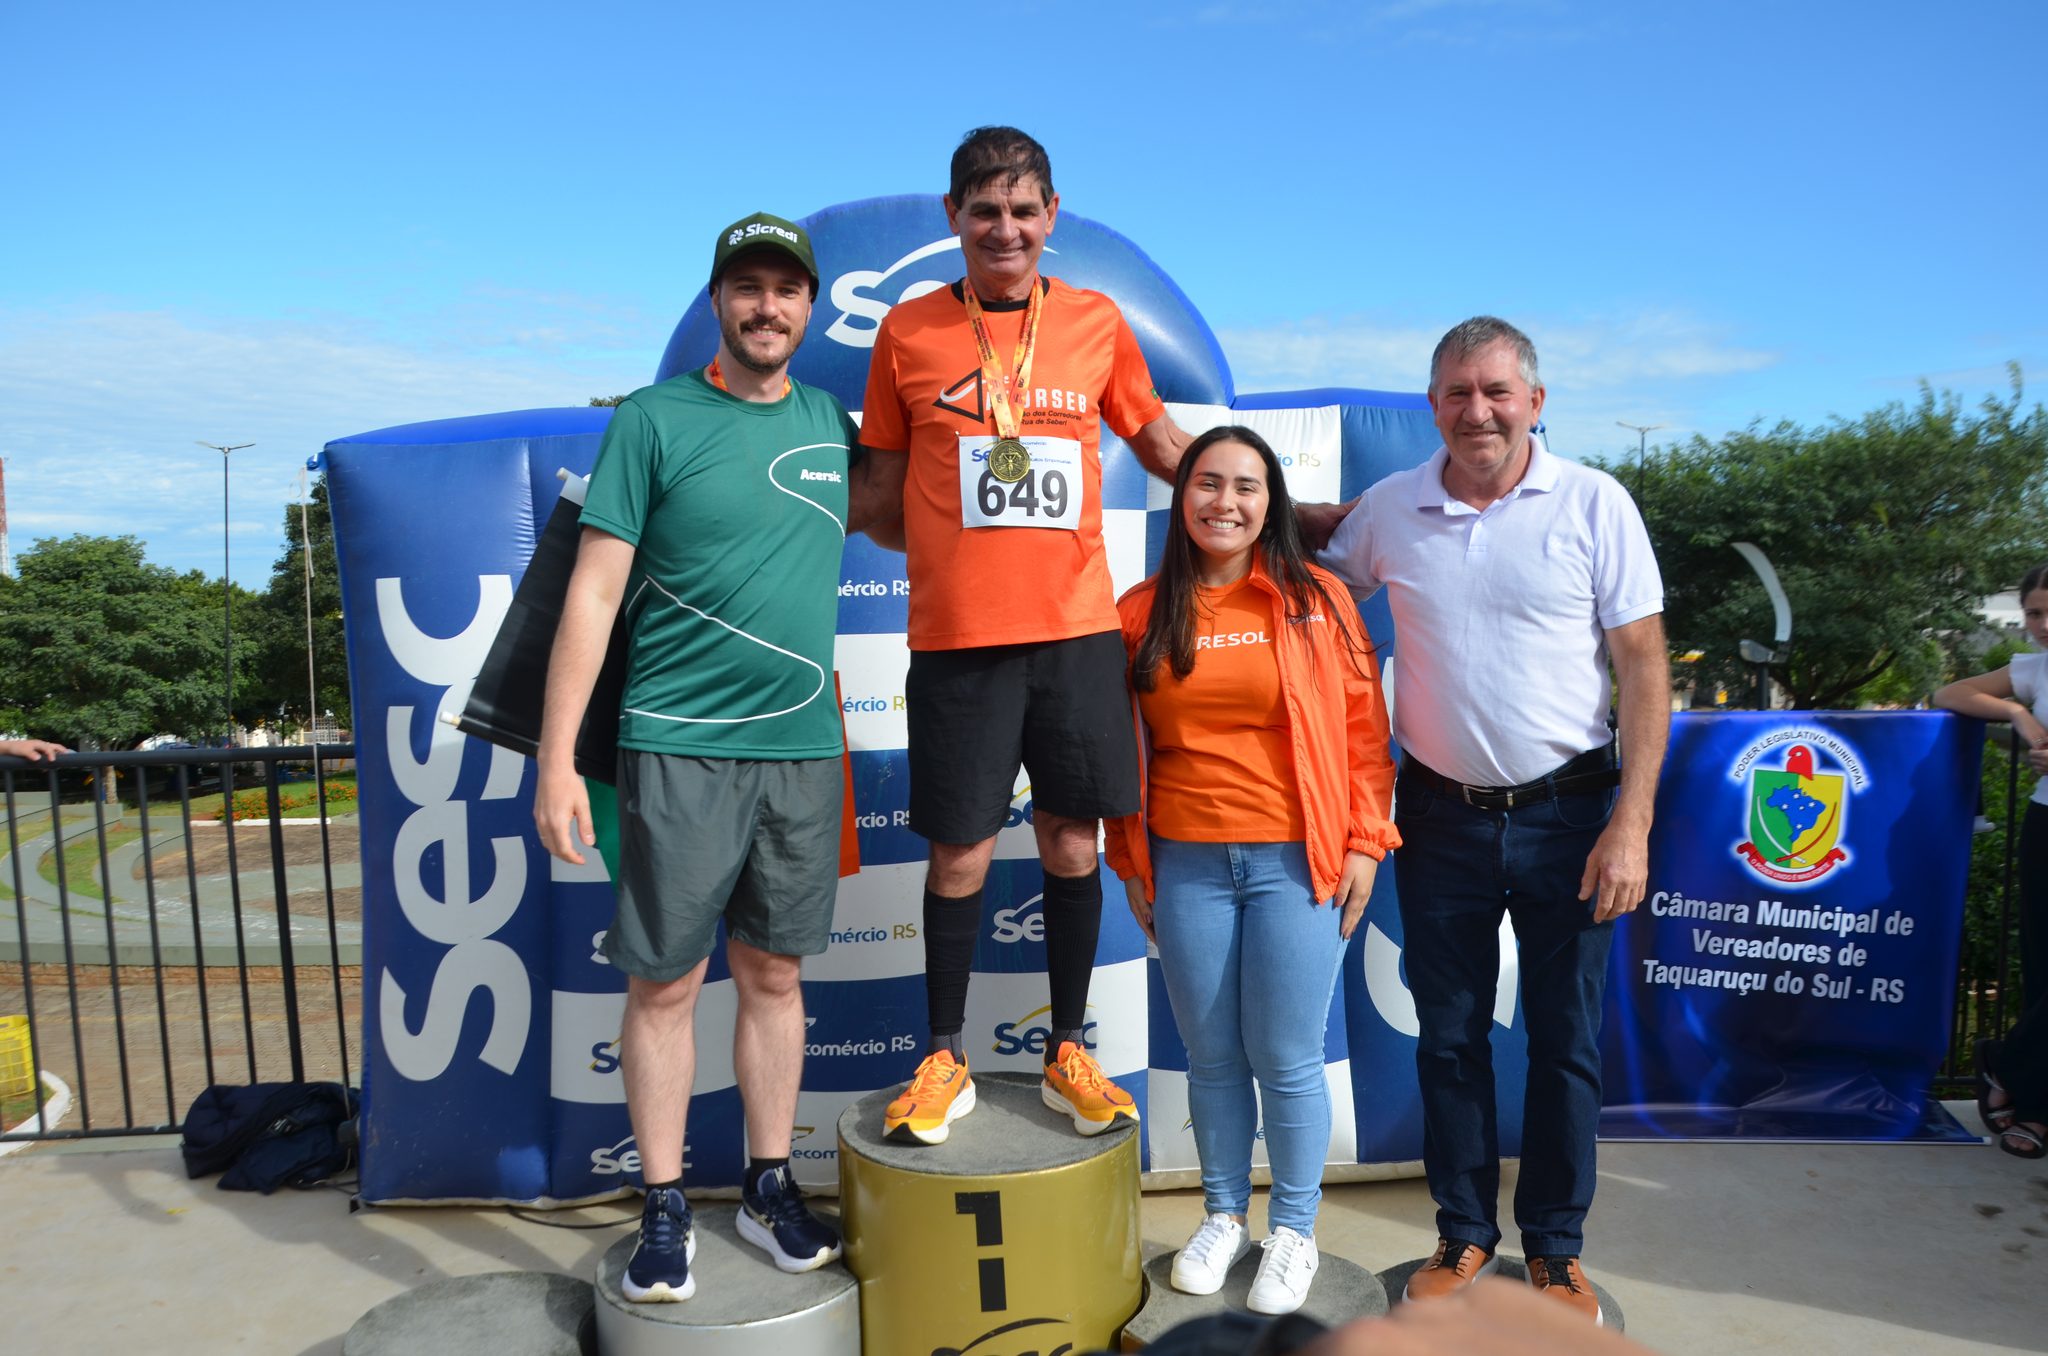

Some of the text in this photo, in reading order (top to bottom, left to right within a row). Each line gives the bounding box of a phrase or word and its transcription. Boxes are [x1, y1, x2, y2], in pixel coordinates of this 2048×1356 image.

[745, 223, 798, 244] Sicredi
[800, 469, 842, 483] Acersic
[977, 469, 1068, 518] 649
[1194, 631, 1271, 650] RESOL
[1734, 731, 1864, 786] PODER LEGISLATIVO MUNICIPAL
[893, 923, 917, 939] RS
[1651, 891, 1914, 938] Câmara Municipal de
[1692, 928, 1867, 967] Vereadores de
[1643, 959, 1767, 996] Taquaruçu
[1773, 971, 1804, 994] do
[1811, 973, 1851, 1000] Sul
[1871, 978, 1904, 1003] RS
[892, 1035, 916, 1052] RS
[955, 1191, 1007, 1312] 1
